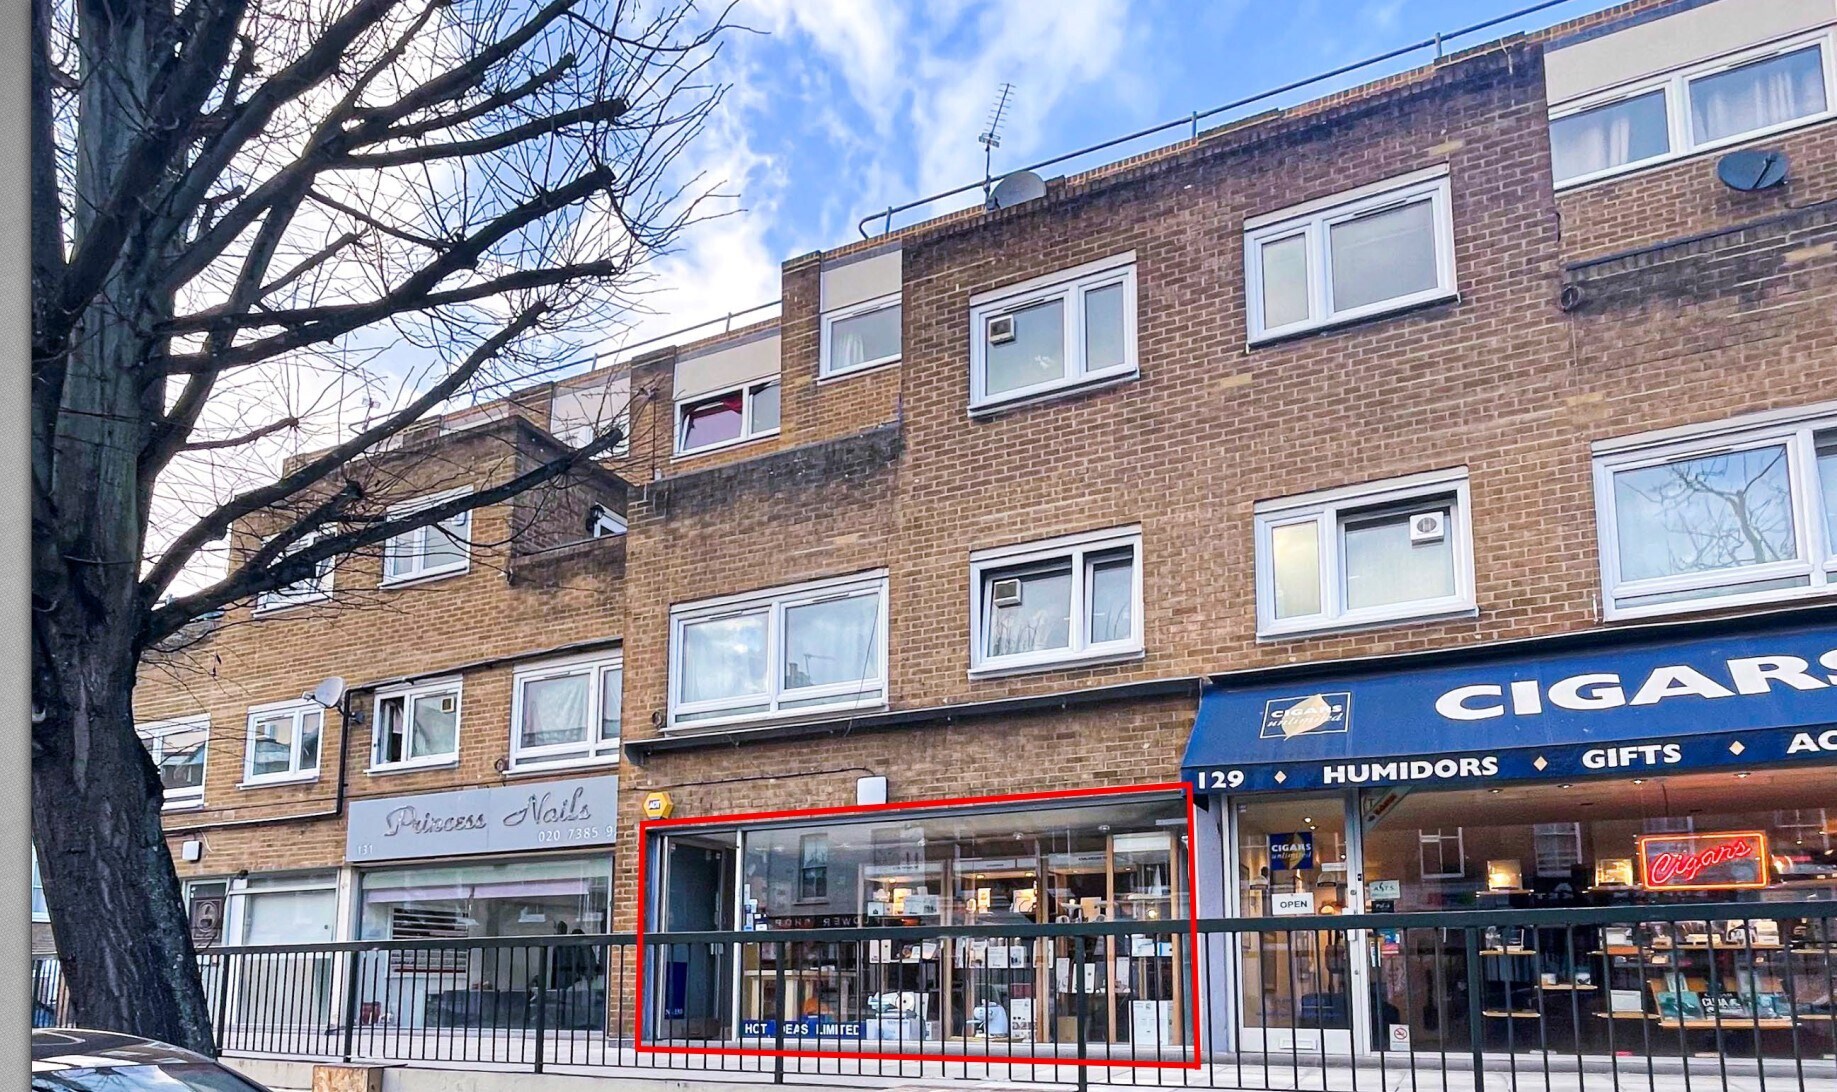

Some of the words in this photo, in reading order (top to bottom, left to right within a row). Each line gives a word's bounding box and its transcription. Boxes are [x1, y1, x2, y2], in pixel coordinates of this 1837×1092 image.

[1581, 743, 1681, 769] GIFTS
[1198, 769, 1244, 789] 129
[1323, 756, 1498, 784] HUMIDORS
[384, 804, 487, 836] Princess
[503, 786, 591, 827] Nails
[538, 830, 561, 842] 020
[568, 826, 598, 840] 7385
[357, 844, 373, 855] 131
[1271, 843, 1312, 852] CIGARS
[1651, 840, 1752, 884] Cigars
[1280, 900, 1308, 909] OPEN
